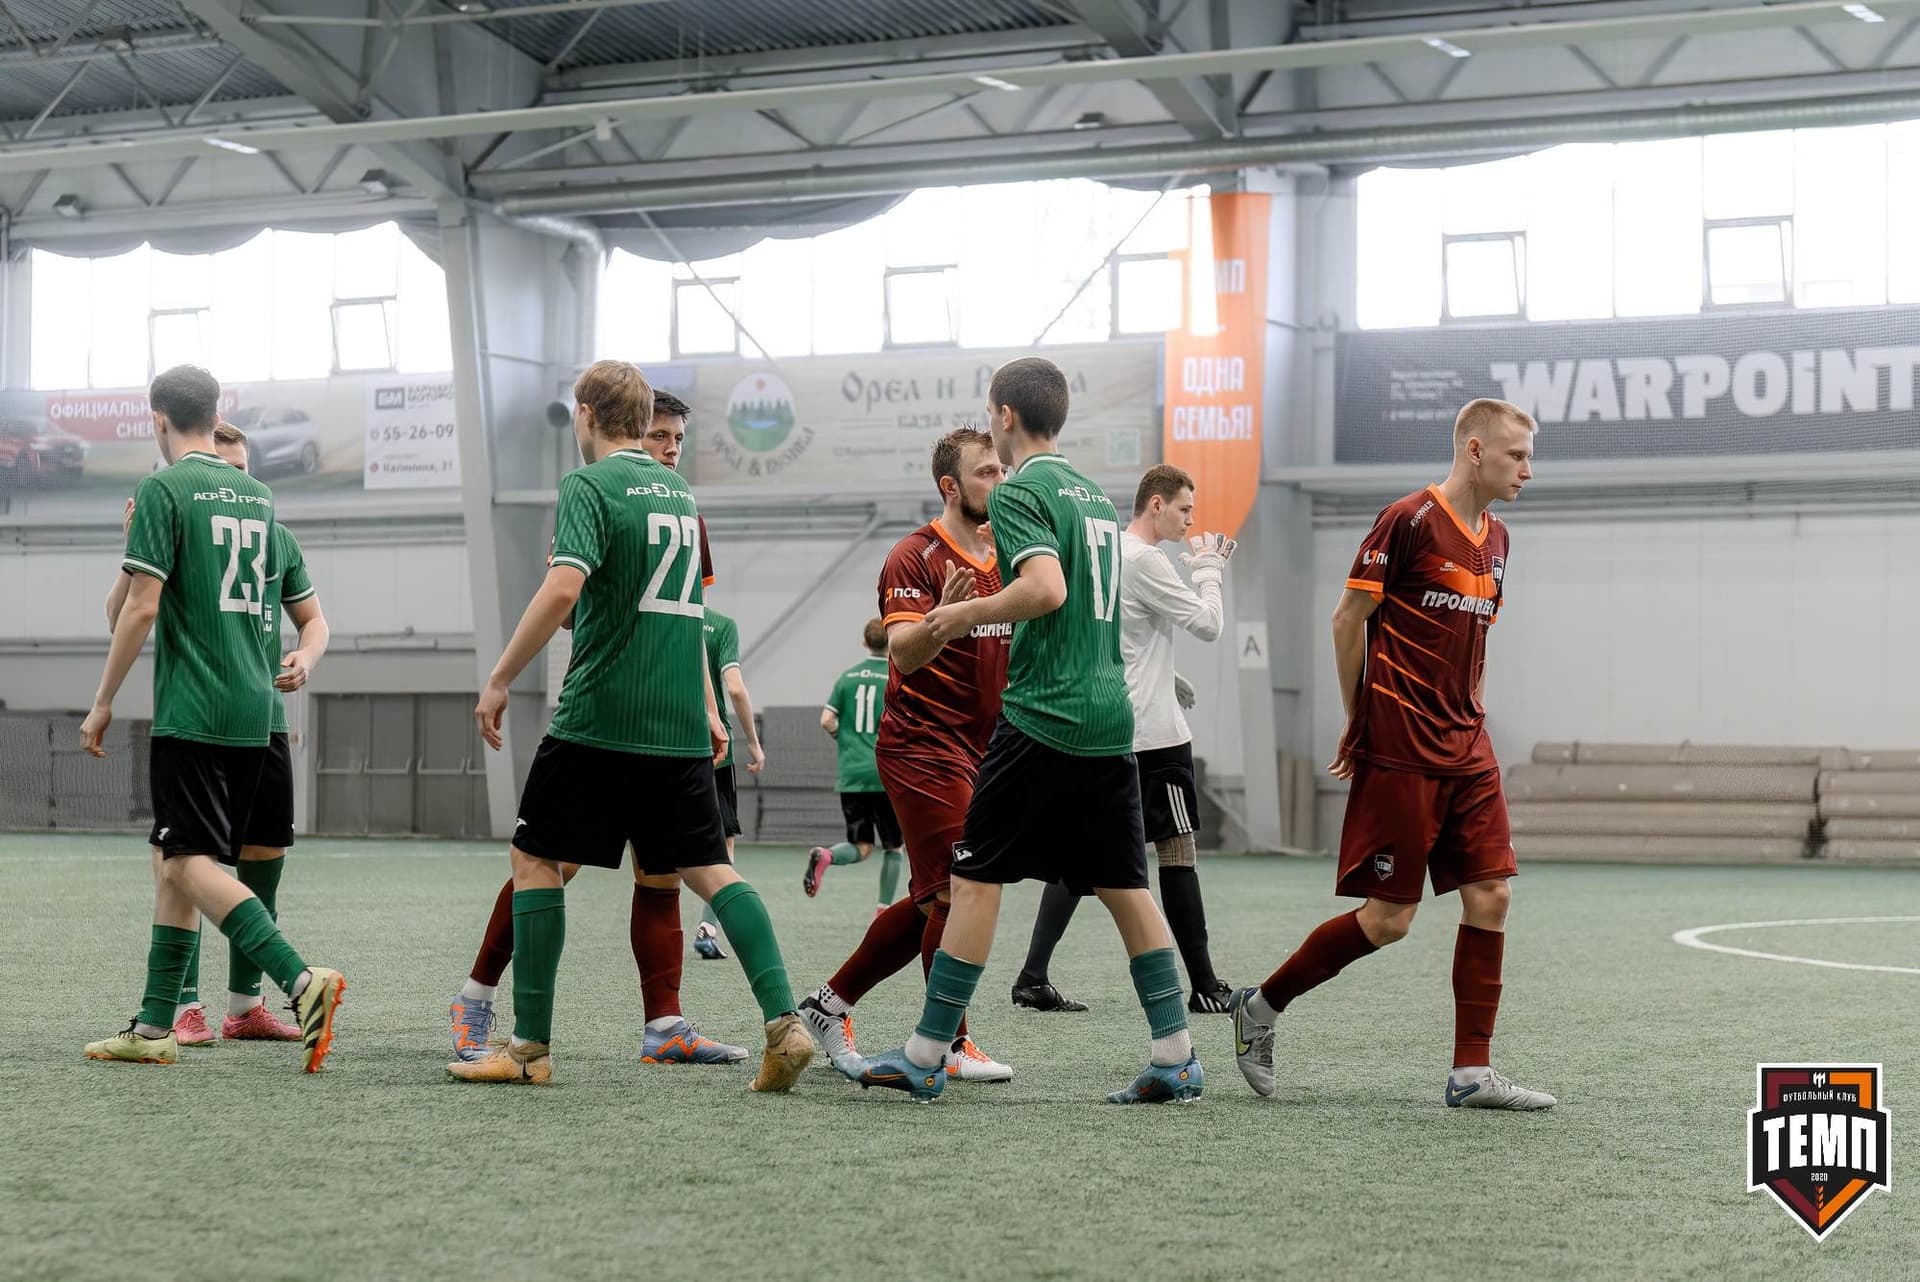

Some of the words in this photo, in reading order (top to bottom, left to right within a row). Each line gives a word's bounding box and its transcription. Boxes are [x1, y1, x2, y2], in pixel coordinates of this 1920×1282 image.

[1183, 356, 1244, 396] ОДНА
[51, 401, 150, 419] ОФИЦИАЛЬН
[1173, 404, 1254, 441] СЕМЬЯ!
[116, 420, 154, 438] CHER
[383, 423, 454, 441] 55-26-09
[211, 515, 267, 615] 23
[638, 512, 704, 619] 22
[1085, 516, 1118, 622] 17
[894, 587, 920, 598] ПСБ
[1243, 634, 1261, 656] А
[855, 684, 876, 733] 11
